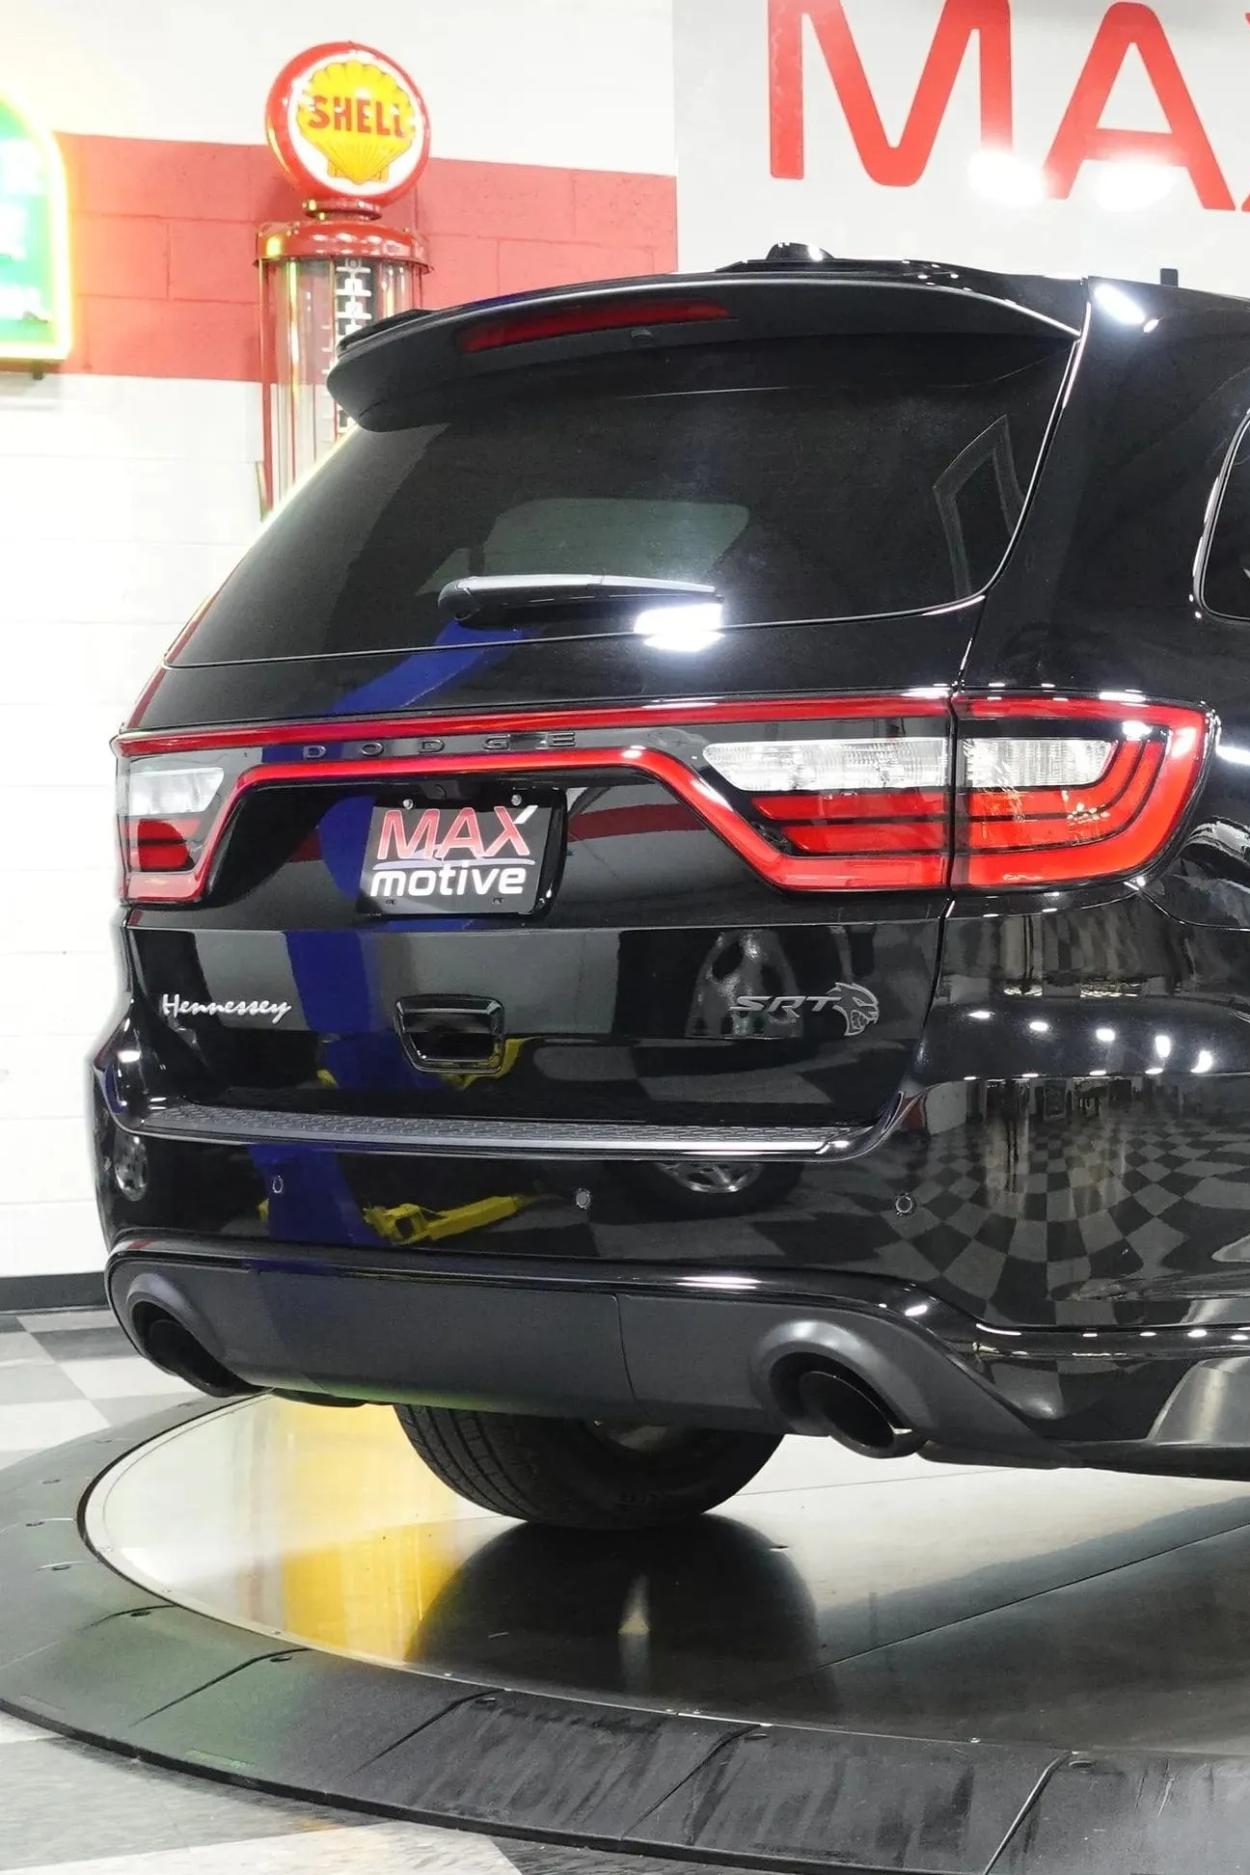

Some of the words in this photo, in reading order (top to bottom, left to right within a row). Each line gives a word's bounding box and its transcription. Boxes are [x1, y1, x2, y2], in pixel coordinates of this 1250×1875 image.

[307, 95, 405, 139] SHELL
[302, 731, 576, 760] DODGE
[376, 804, 539, 861] MAX
[369, 860, 528, 898] motive
[162, 993, 292, 1024] Hennessey
[729, 995, 842, 1018] SRT
